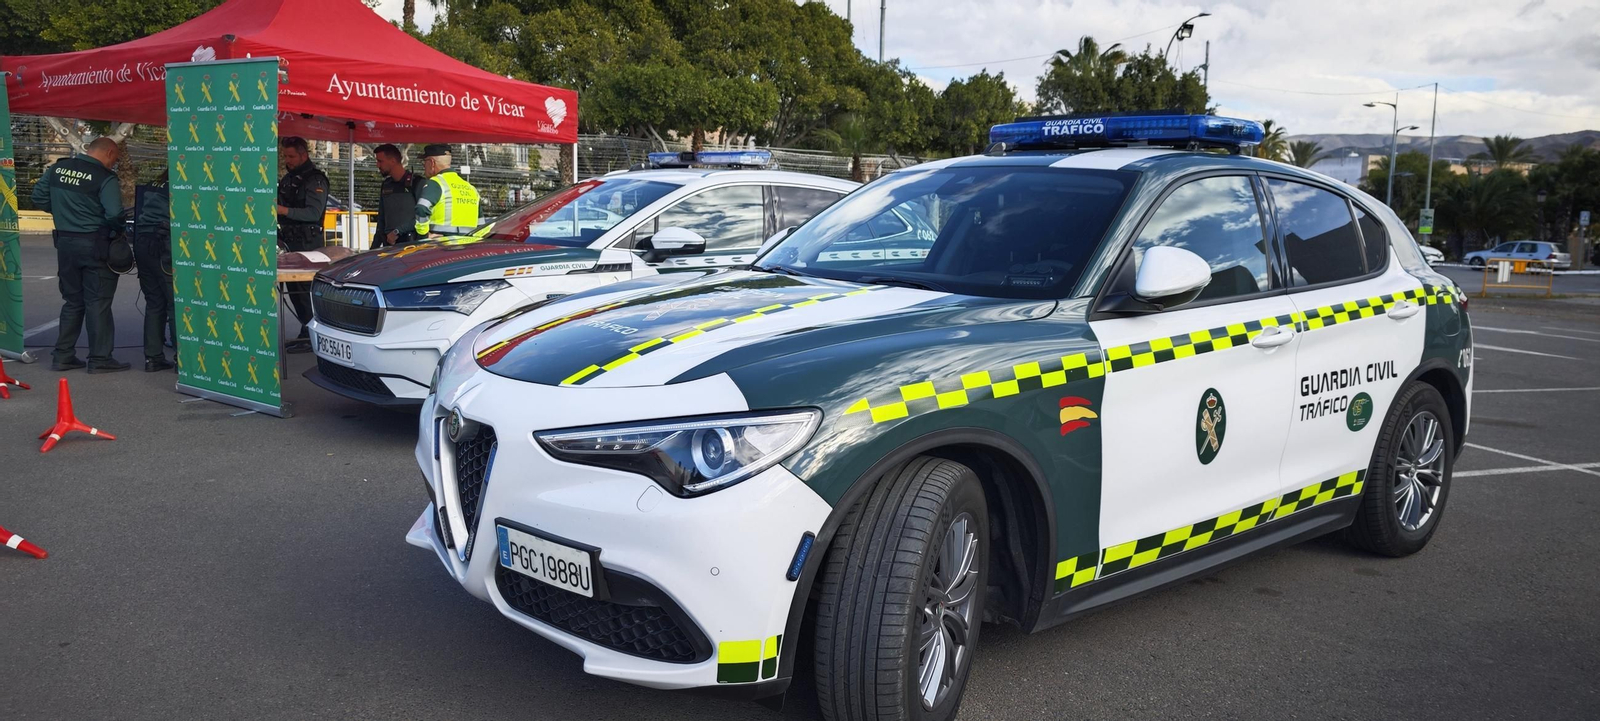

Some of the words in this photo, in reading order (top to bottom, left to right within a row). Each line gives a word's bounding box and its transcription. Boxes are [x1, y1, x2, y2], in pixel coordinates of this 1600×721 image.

[38, 66, 113, 92] Ayuntamiento
[116, 64, 132, 82] de
[137, 62, 166, 81] Víca
[326, 73, 456, 108] Ayuntamiento
[460, 92, 480, 110] de
[483, 95, 525, 118] Vícar
[56, 167, 92, 180] GUARDIA
[60, 176, 80, 186] CIVIL
[1300, 366, 1361, 396] GUARDIA
[1366, 360, 1398, 382] CIVIL
[1300, 395, 1348, 422] TRÁFICO
[502, 550, 508, 560] E
